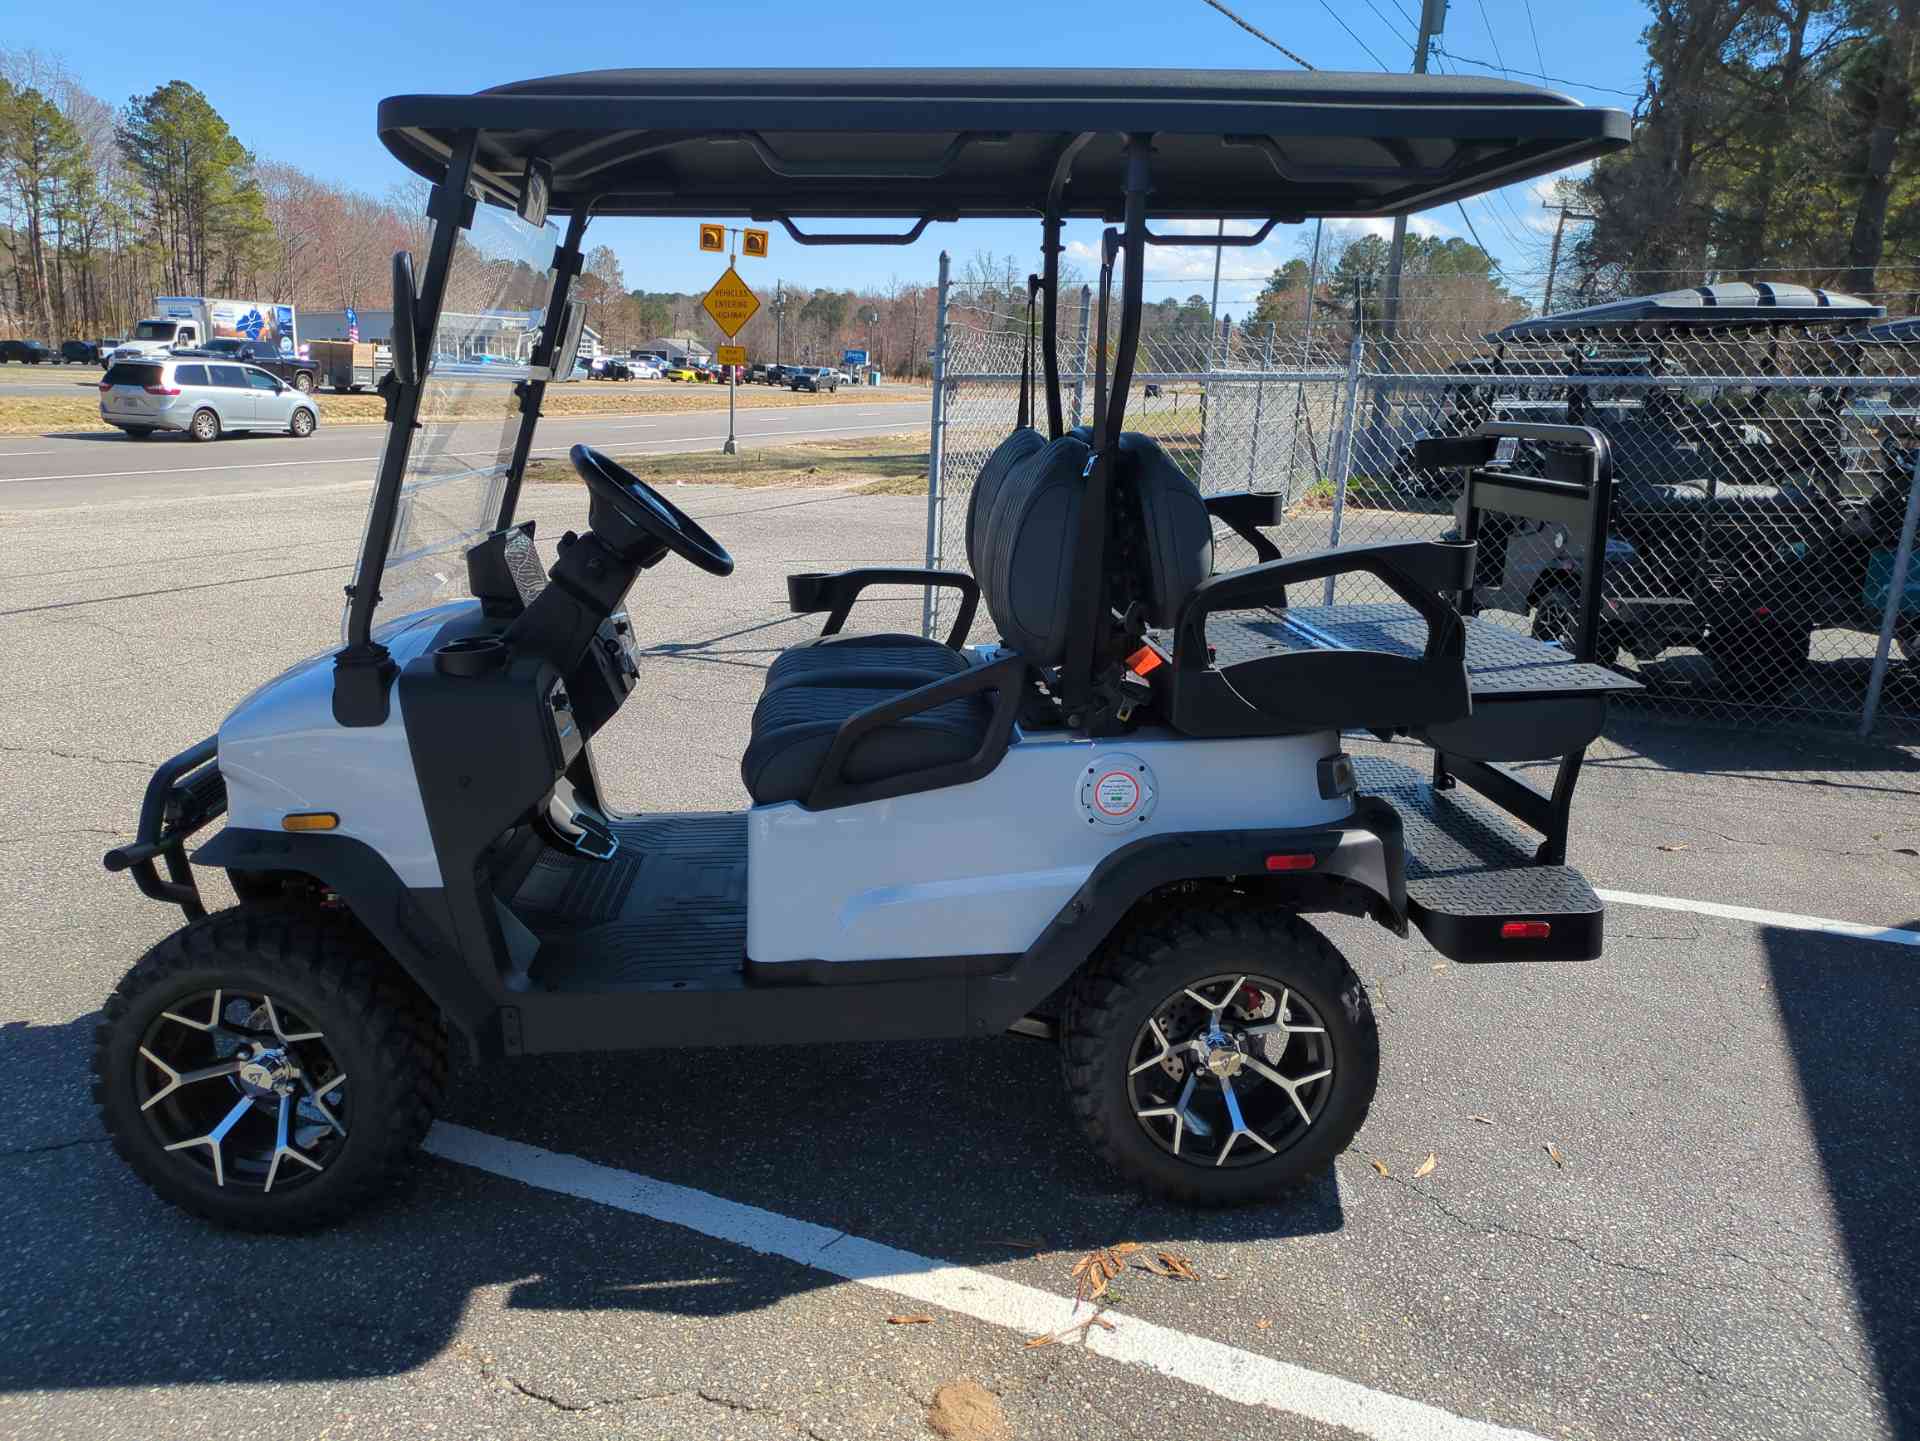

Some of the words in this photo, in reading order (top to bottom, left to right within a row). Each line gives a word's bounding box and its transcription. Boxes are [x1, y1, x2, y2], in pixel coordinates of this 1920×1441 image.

[715, 288, 748, 297] VEHICLES
[715, 300, 748, 309] ENTERING
[716, 311, 748, 320] HIGHWAY
